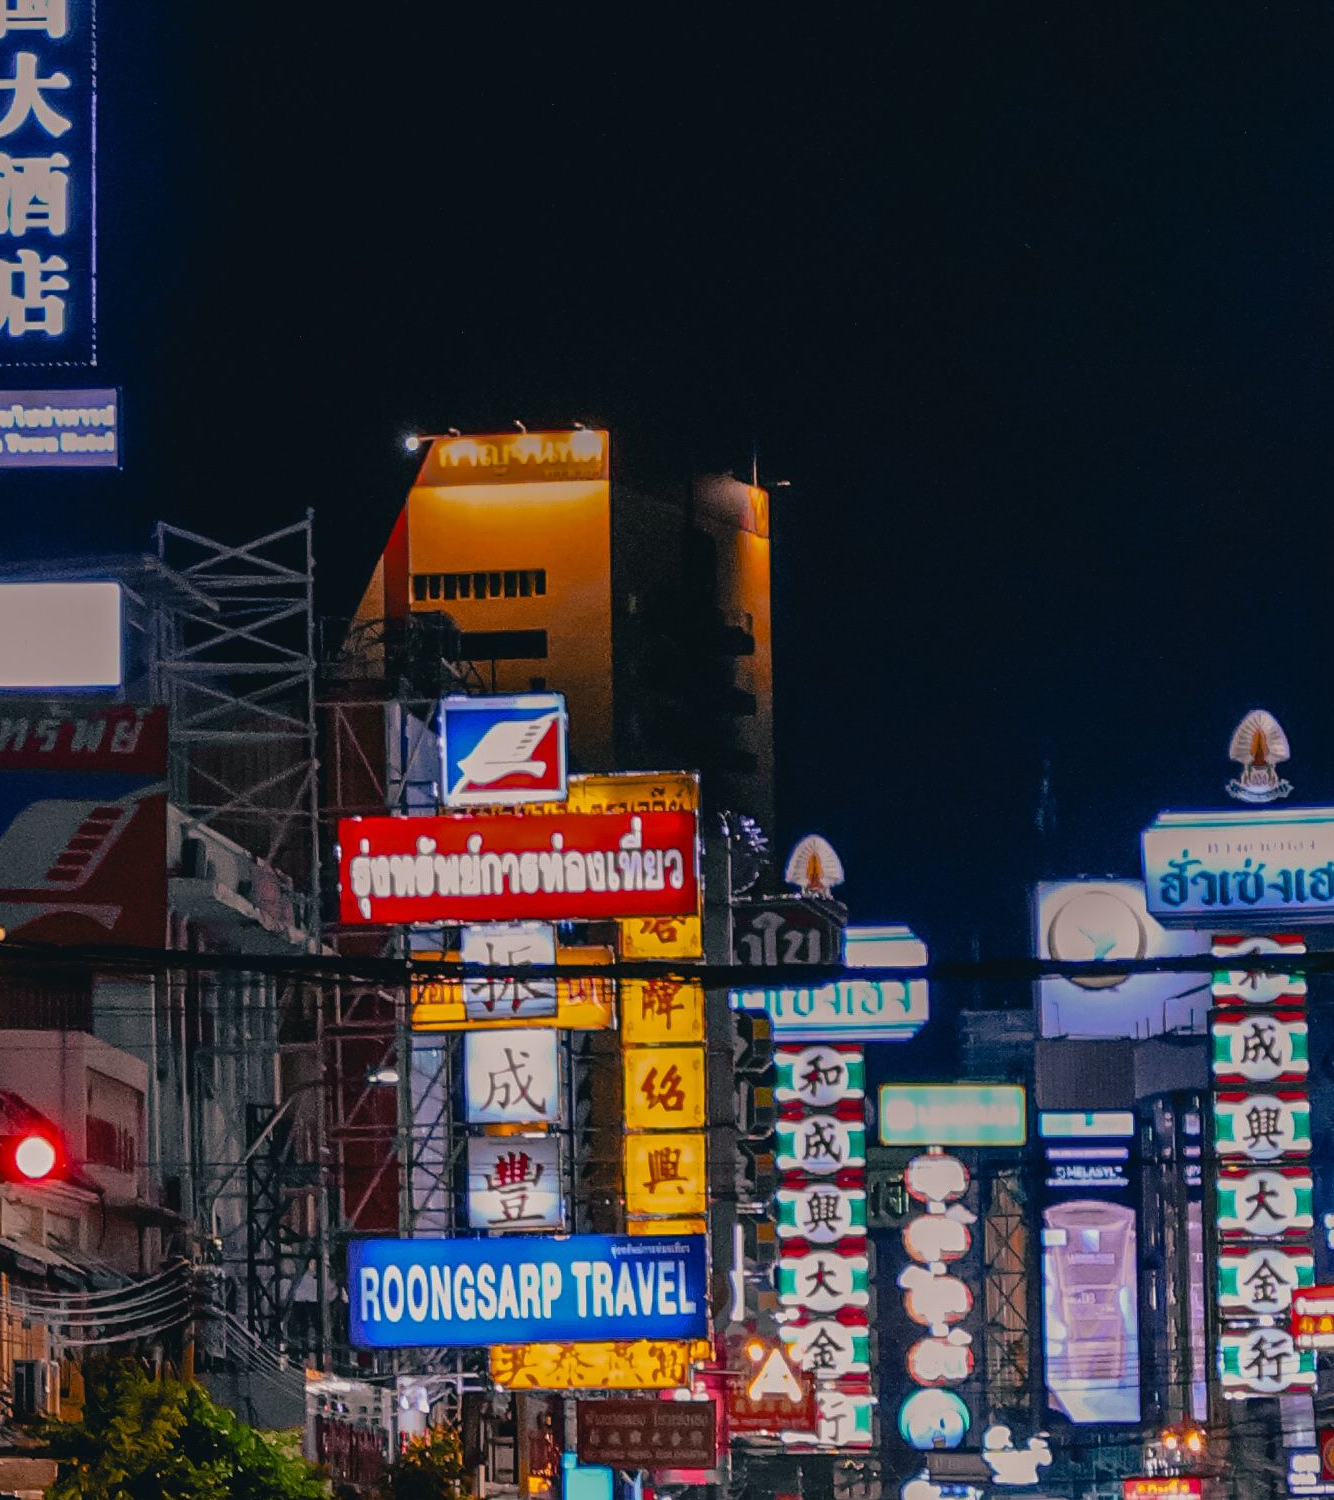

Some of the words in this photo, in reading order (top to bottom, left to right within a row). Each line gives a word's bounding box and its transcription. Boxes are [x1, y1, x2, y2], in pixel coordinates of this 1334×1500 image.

[350, 816, 684, 920] รุ่งทรัพย์การท่องเที่ยว
[361, 1262, 562, 1322] ROONGSARP
[570, 1260, 696, 1317] TRAVEL
